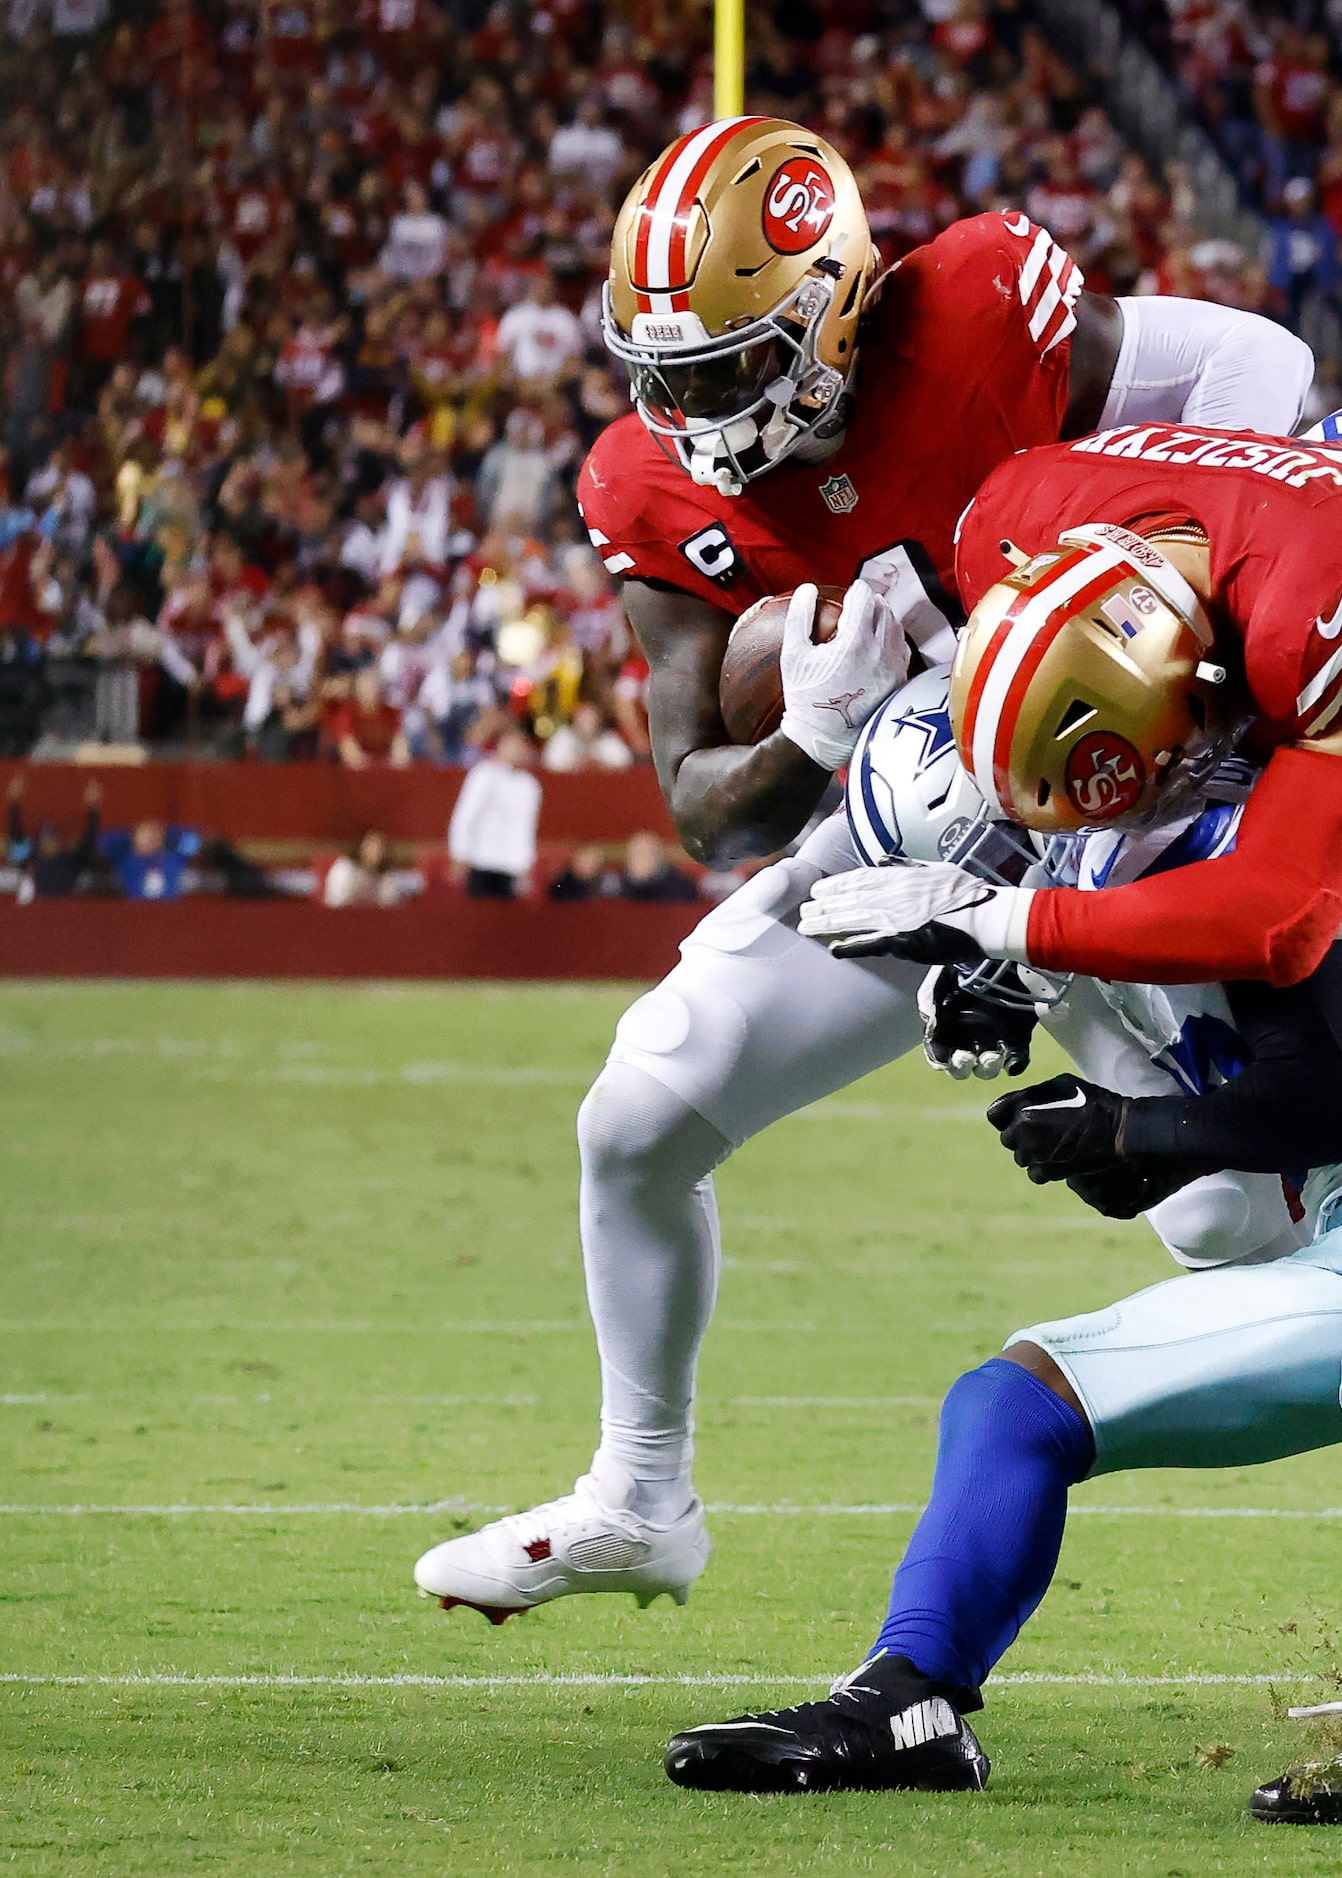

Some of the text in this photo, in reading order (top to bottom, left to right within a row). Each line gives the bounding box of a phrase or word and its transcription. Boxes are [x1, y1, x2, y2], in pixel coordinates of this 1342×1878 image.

[828, 488, 857, 511] NFL
[684, 528, 735, 577] C
[1131, 588, 1159, 615] 37
[1071, 748, 1137, 811] SF
